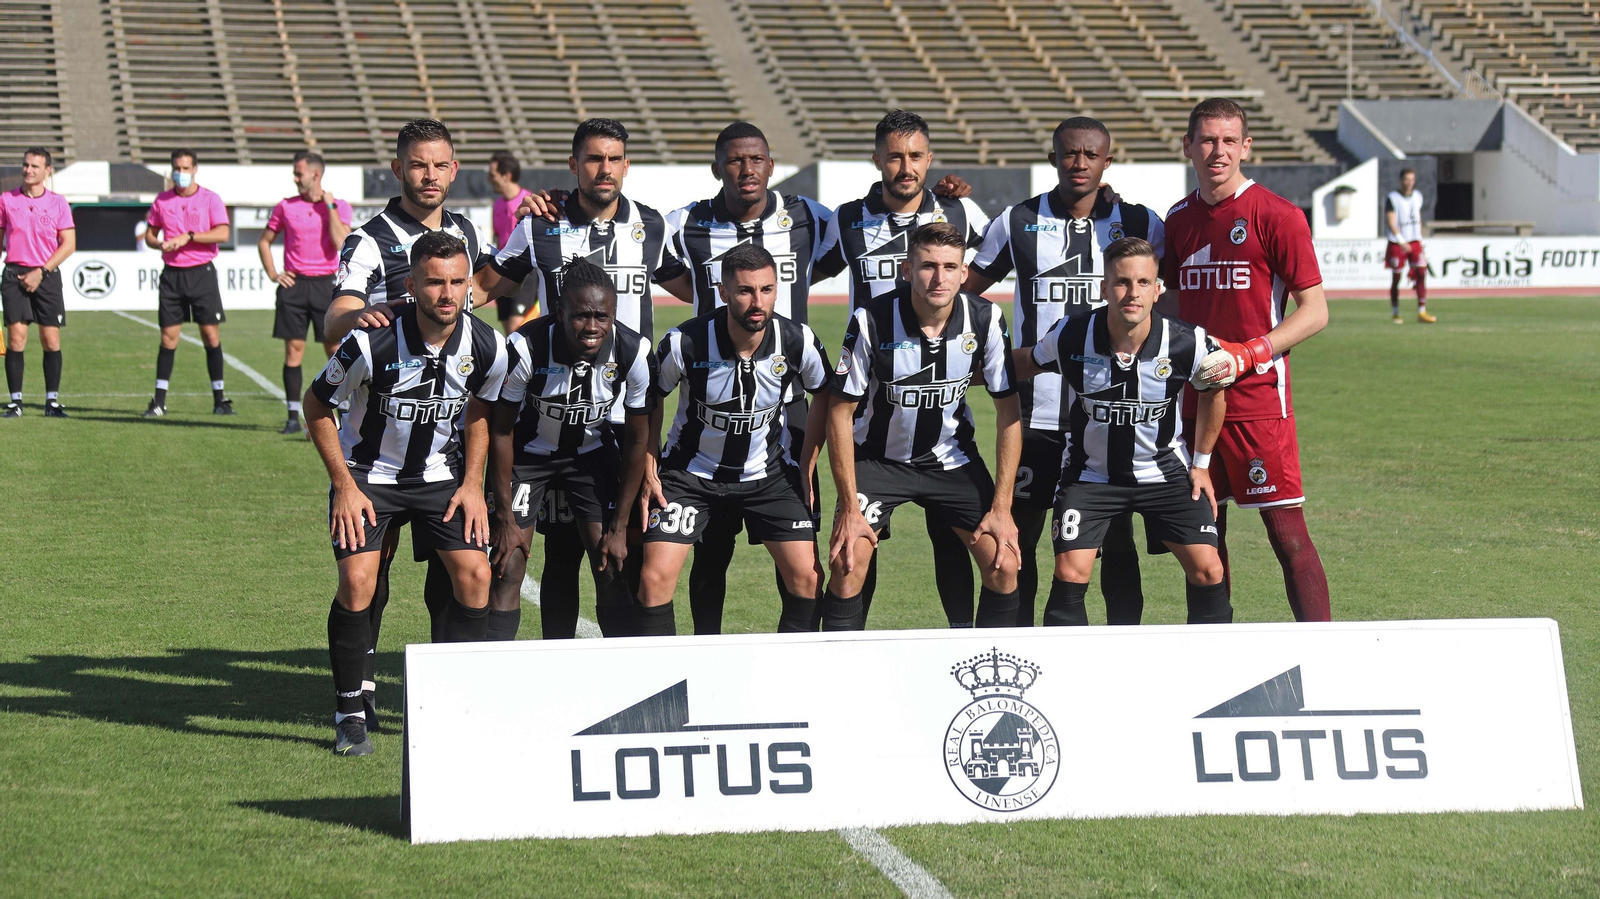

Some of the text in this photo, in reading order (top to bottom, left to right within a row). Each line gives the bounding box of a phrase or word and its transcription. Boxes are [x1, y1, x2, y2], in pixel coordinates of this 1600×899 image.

[546, 227, 579, 236] LEGEA
[697, 219, 730, 230] LEGEA
[852, 219, 883, 229] LEGEA
[1023, 224, 1058, 232] LEGEA
[227, 268, 265, 291] RFEF
[1179, 267, 1251, 291] LOTUS
[880, 342, 915, 350] LEGEA
[385, 359, 422, 372] LEGEA
[535, 366, 565, 375] LEGEA
[692, 361, 728, 369] LEGEA
[1070, 354, 1104, 366] LEGEA
[886, 378, 971, 409] LOTUS
[379, 394, 468, 424] LOTUS
[533, 396, 613, 425] LOTUS
[696, 401, 780, 435] LOTUS
[510, 481, 532, 518] 4
[1246, 484, 1277, 495] LEGEA
[545, 489, 575, 524] 15
[659, 501, 699, 536] 30
[1061, 508, 1081, 541] 8
[948, 699, 1057, 768] REAL BALOMPEDICA
[1191, 728, 1429, 783] LOTUS
[571, 741, 813, 802] LOTUS
[975, 787, 1042, 809] LINENSE
